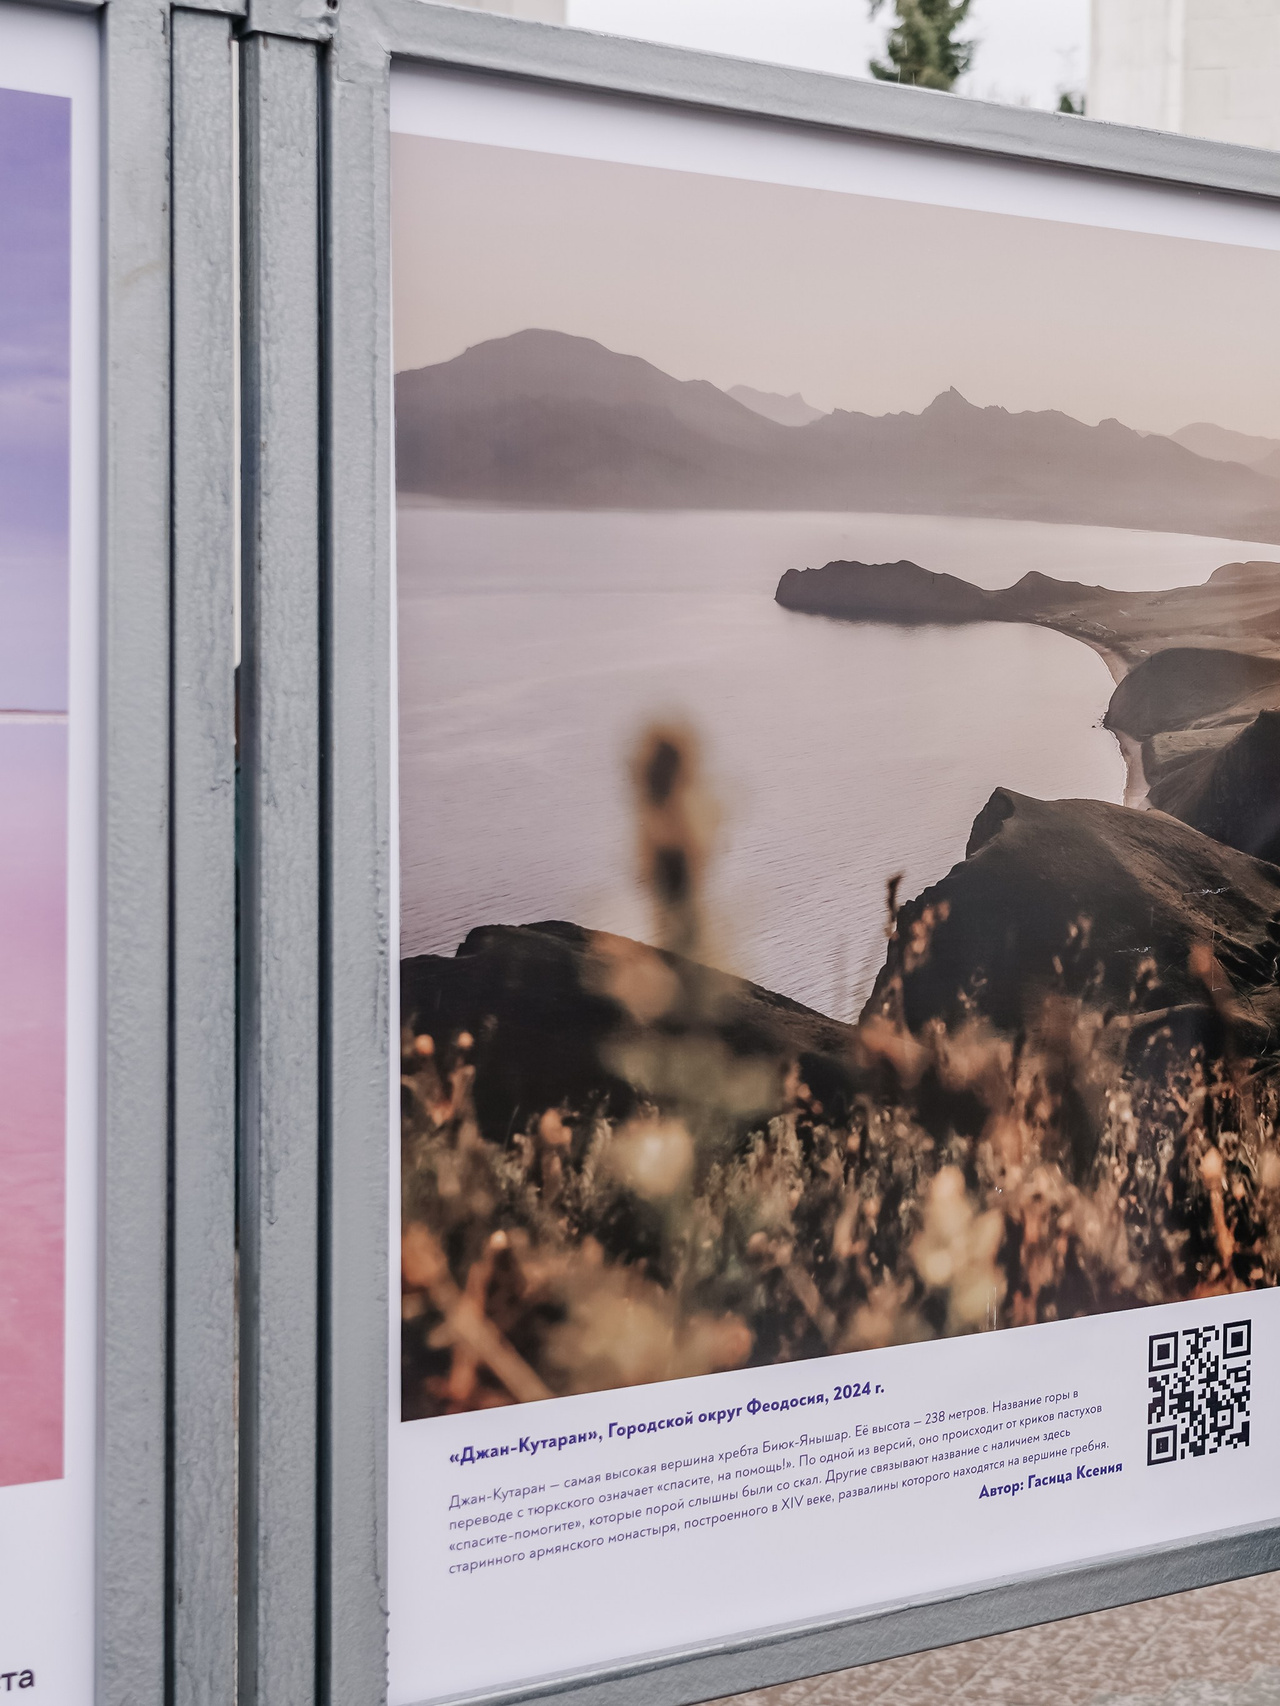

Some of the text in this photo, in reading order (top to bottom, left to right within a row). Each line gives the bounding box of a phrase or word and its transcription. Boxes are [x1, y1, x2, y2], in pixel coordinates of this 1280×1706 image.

[449, 1381, 885, 1467] «Джан-Кутаран», Городской округ Феодосия, 2024 г.
[449, 1484, 546, 1511] Джан-Кутаран
[563, 1474, 601, 1488] самая
[605, 1464, 657, 1481] высокая
[660, 1454, 715, 1472] вершина
[718, 1444, 759, 1464] хребта
[762, 1431, 851, 1454] Биюк-Янышар.
[855, 1424, 869, 1438] Её
[872, 1420, 910, 1435] высота
[925, 1410, 946, 1425] 238
[948, 1406, 989, 1421] метров.
[992, 1396, 1042, 1413] Название
[1044, 1391, 1070, 1405] горы
[1073, 1390, 1079, 1399] в
[449, 1405, 1103, 1531] переводе с тюркского означает «спасите, на помощь!». По одной из версий, оно происходит от криков пастухов
[978, 1462, 1123, 1500] Автор: Гасица Ксения
[448, 1439, 1109, 1574] старинного армянского монастыря, построенного в XIV веке, развалины которого находятся на вершине гребня.
[449, 1429, 1071, 1551] «спасите-помогите», которые порой слышны были со скал. Другие связывают название с наличием здесь
